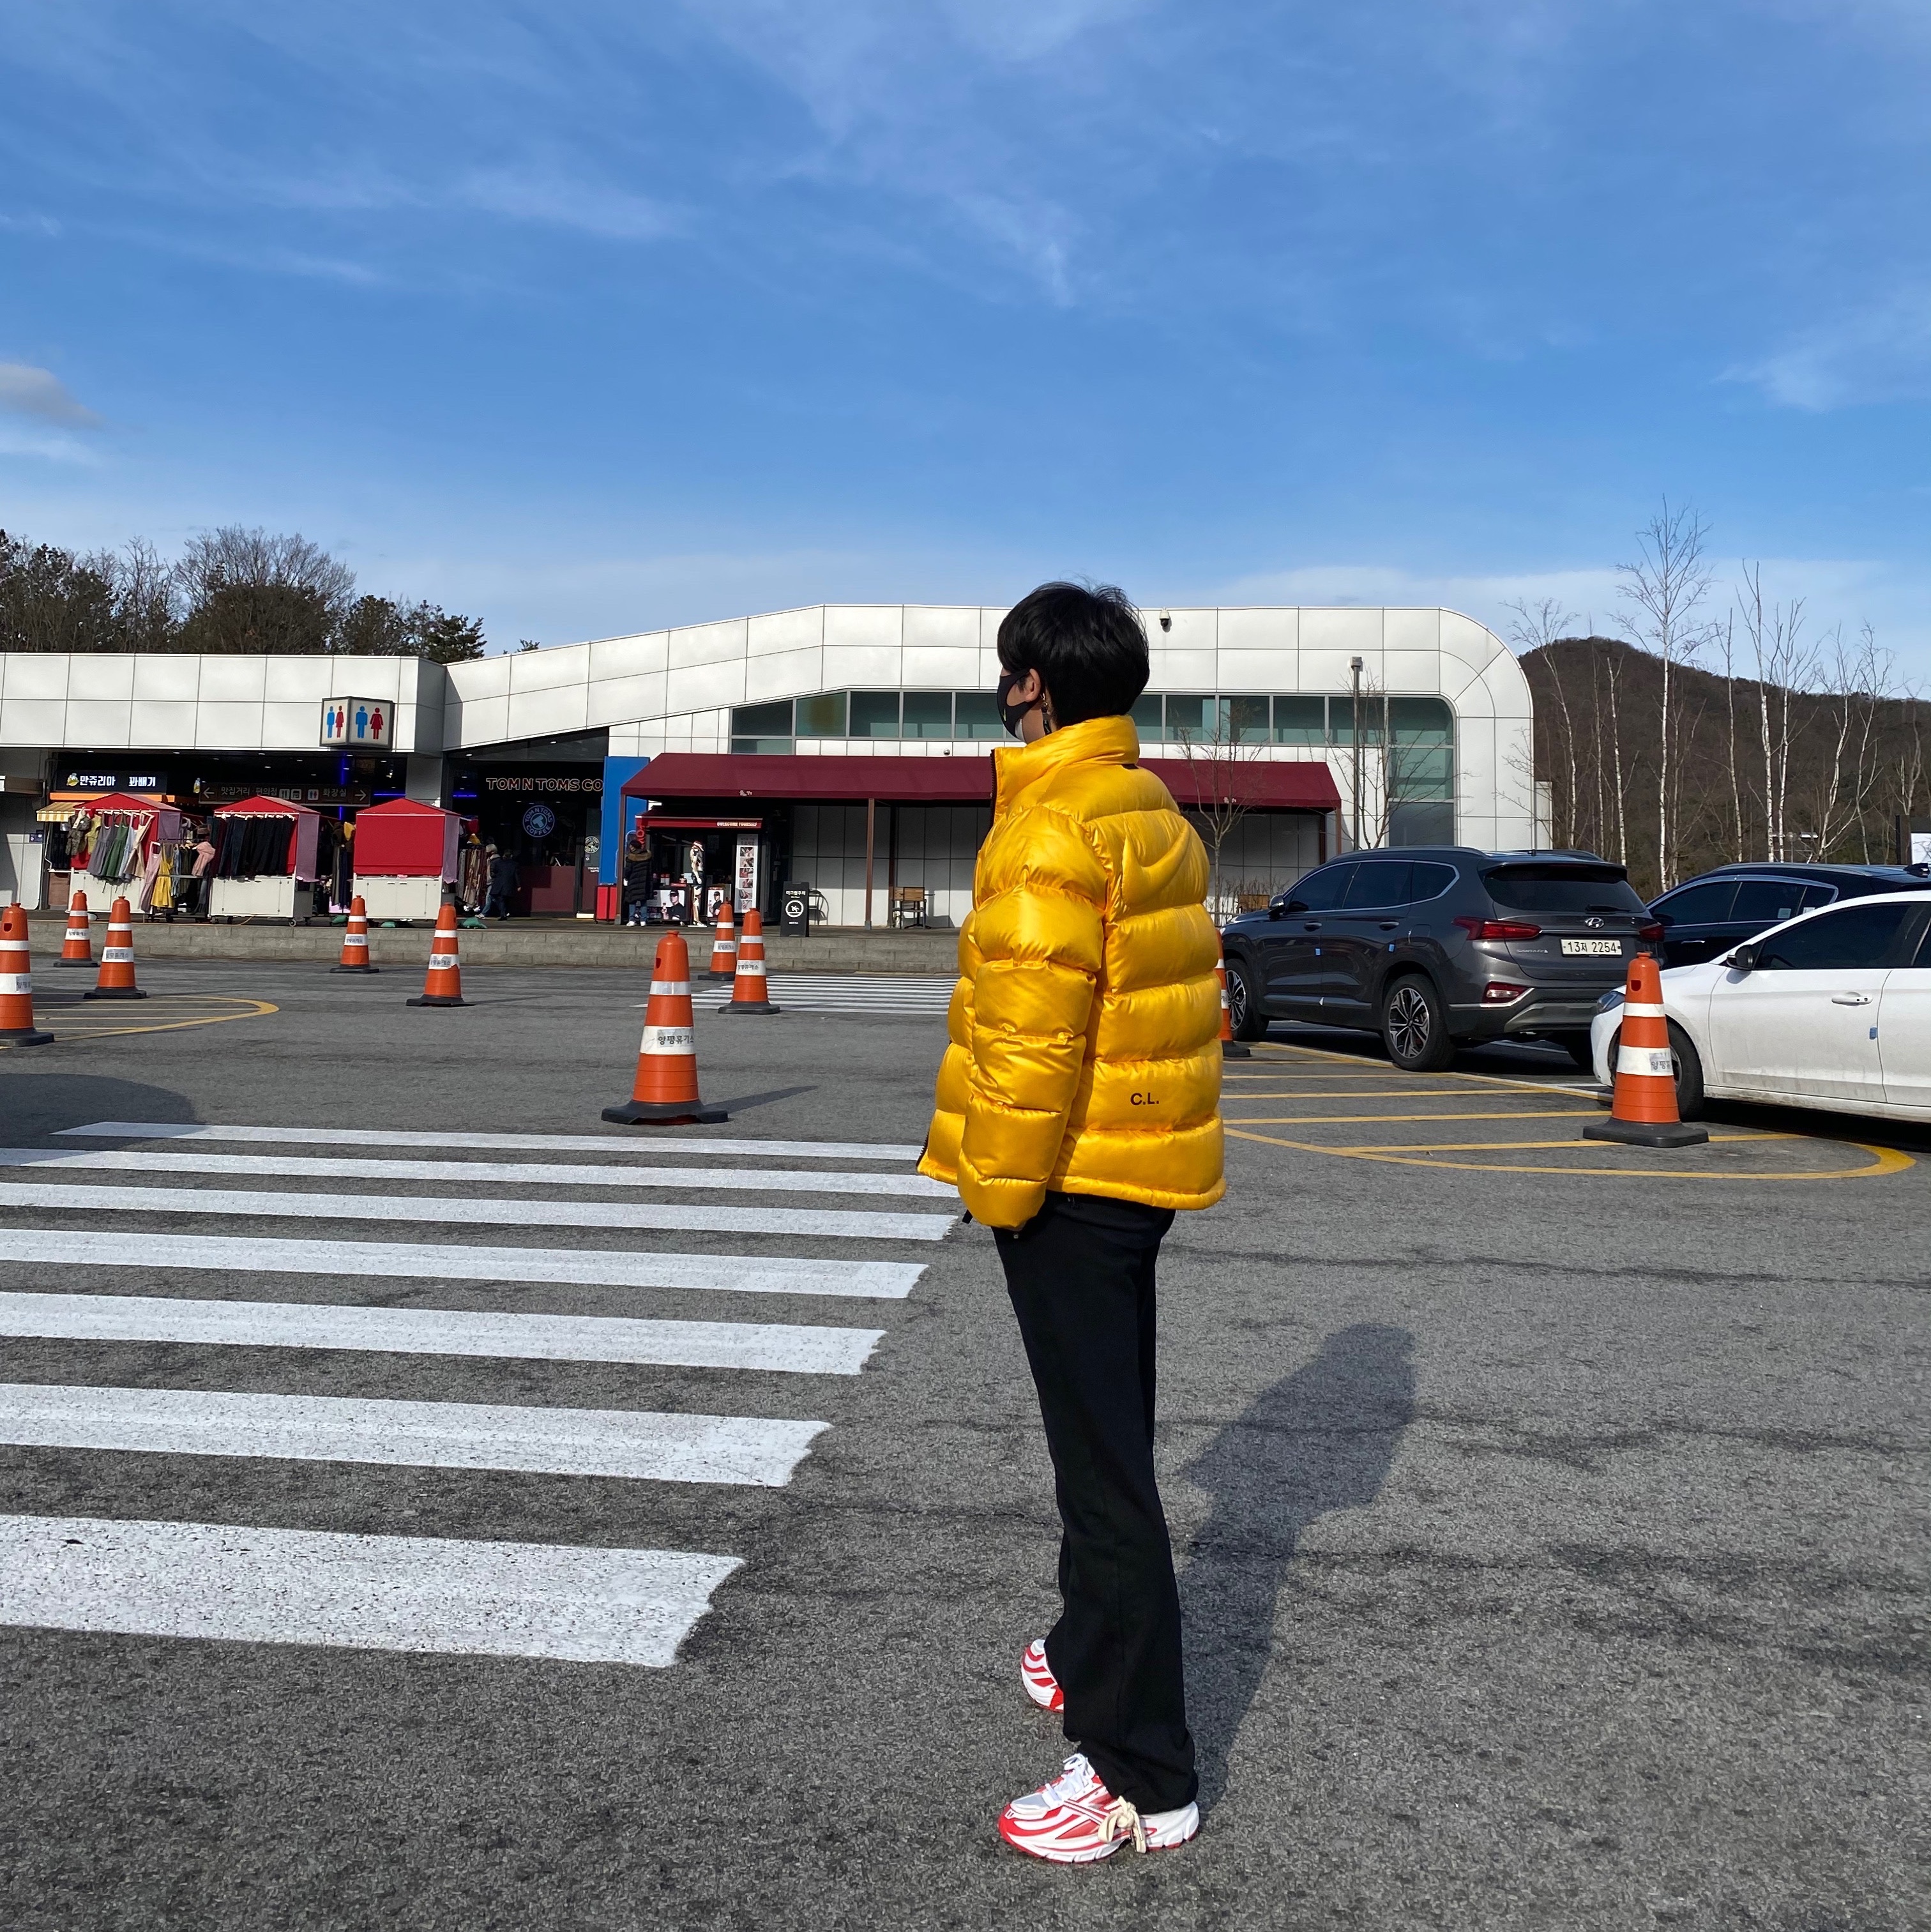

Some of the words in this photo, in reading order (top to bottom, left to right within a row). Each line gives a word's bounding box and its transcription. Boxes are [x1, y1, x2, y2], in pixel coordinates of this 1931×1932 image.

[79, 775, 116, 786] 만쥬리아
[128, 776, 156, 787] 꽈배기
[486, 777, 520, 791] TOM
[522, 778, 534, 791] N
[536, 778, 580, 791] TOMS
[221, 786, 250, 796] 맛집거리
[322, 787, 347, 797] 화장실
[525, 809, 534, 823] TOM
[540, 807, 553, 823] TOMS
[526, 825, 550, 835] COFFEE
[1592, 941, 1617, 953] 2254
[1130, 1092, 1160, 1106] C.L.
